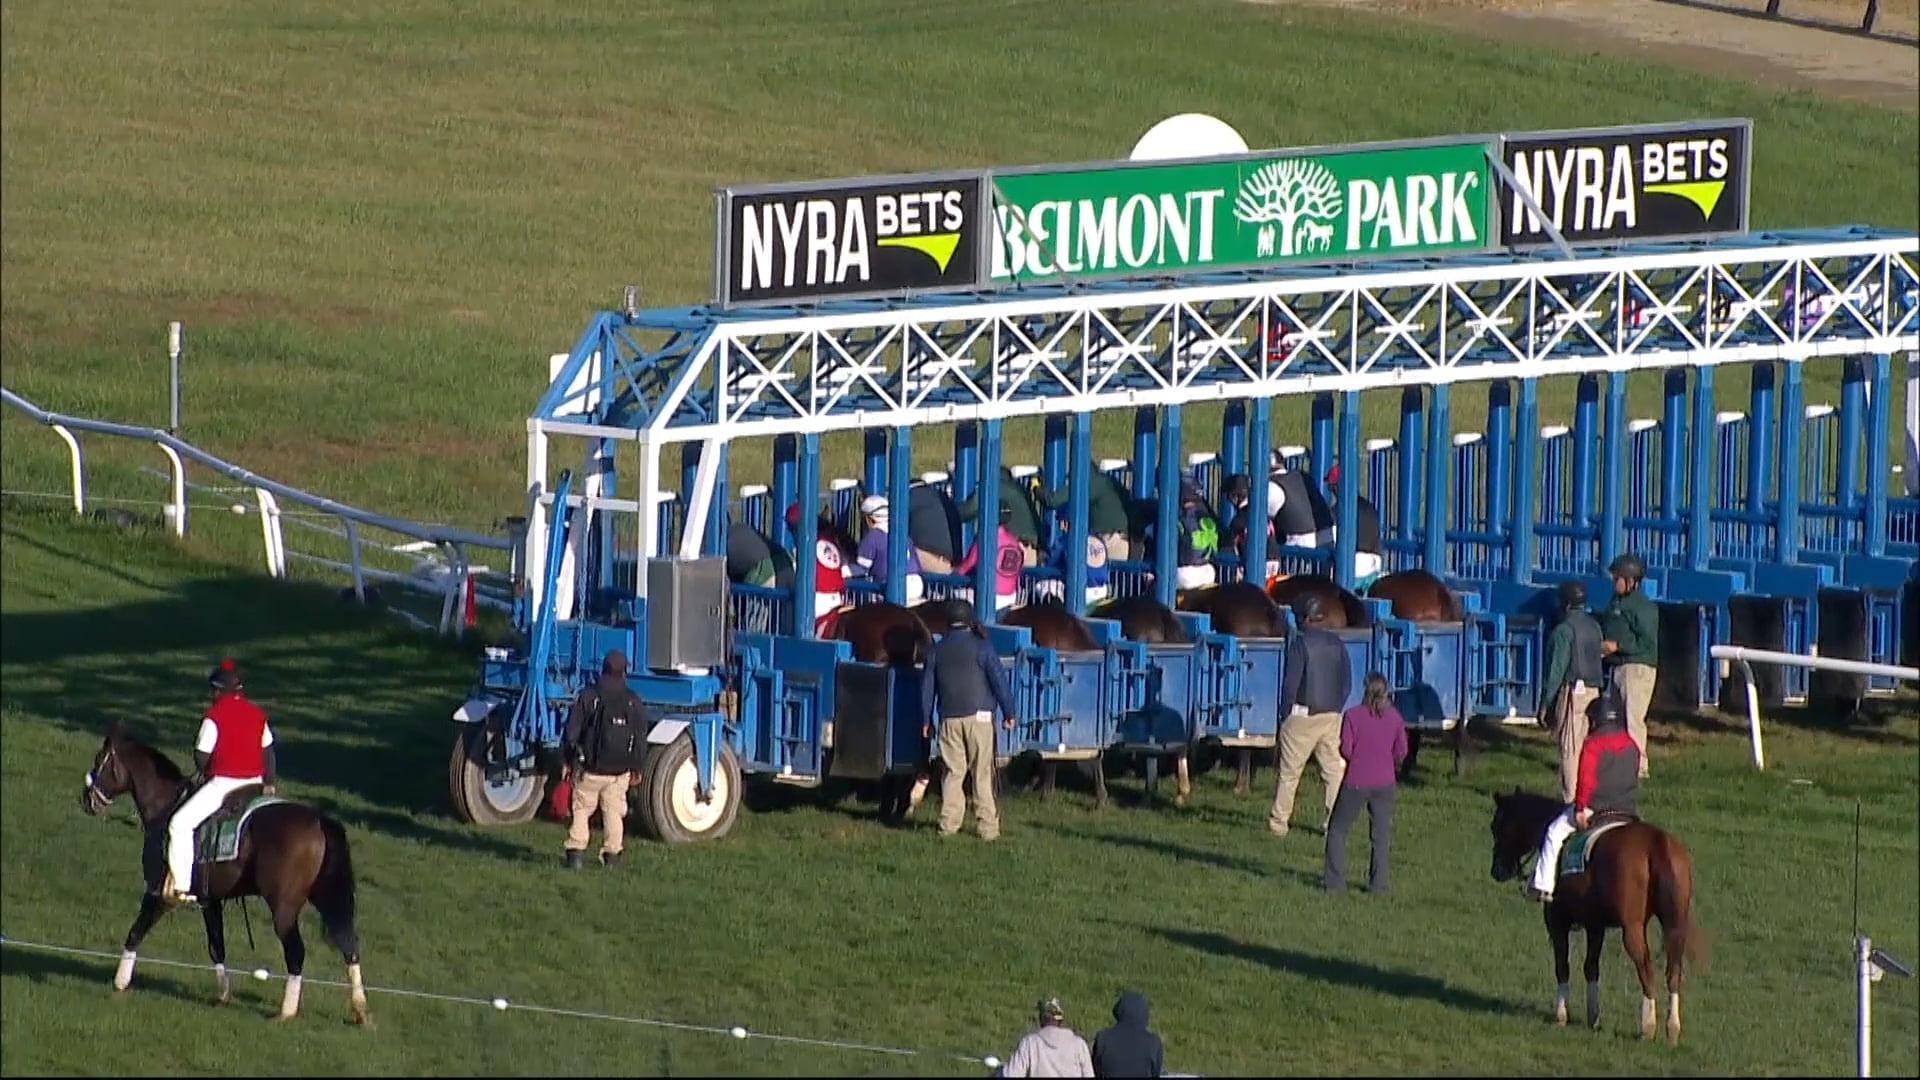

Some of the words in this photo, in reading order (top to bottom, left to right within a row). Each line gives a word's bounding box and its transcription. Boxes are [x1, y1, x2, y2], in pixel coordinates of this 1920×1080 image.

[991, 189, 1224, 278] BELMONT
[1345, 171, 1477, 250] PARK
[1511, 144, 1636, 234] NYRA
[1643, 138, 1728, 182] BETS
[741, 197, 870, 290] NYRA
[876, 190, 963, 235] BETS
